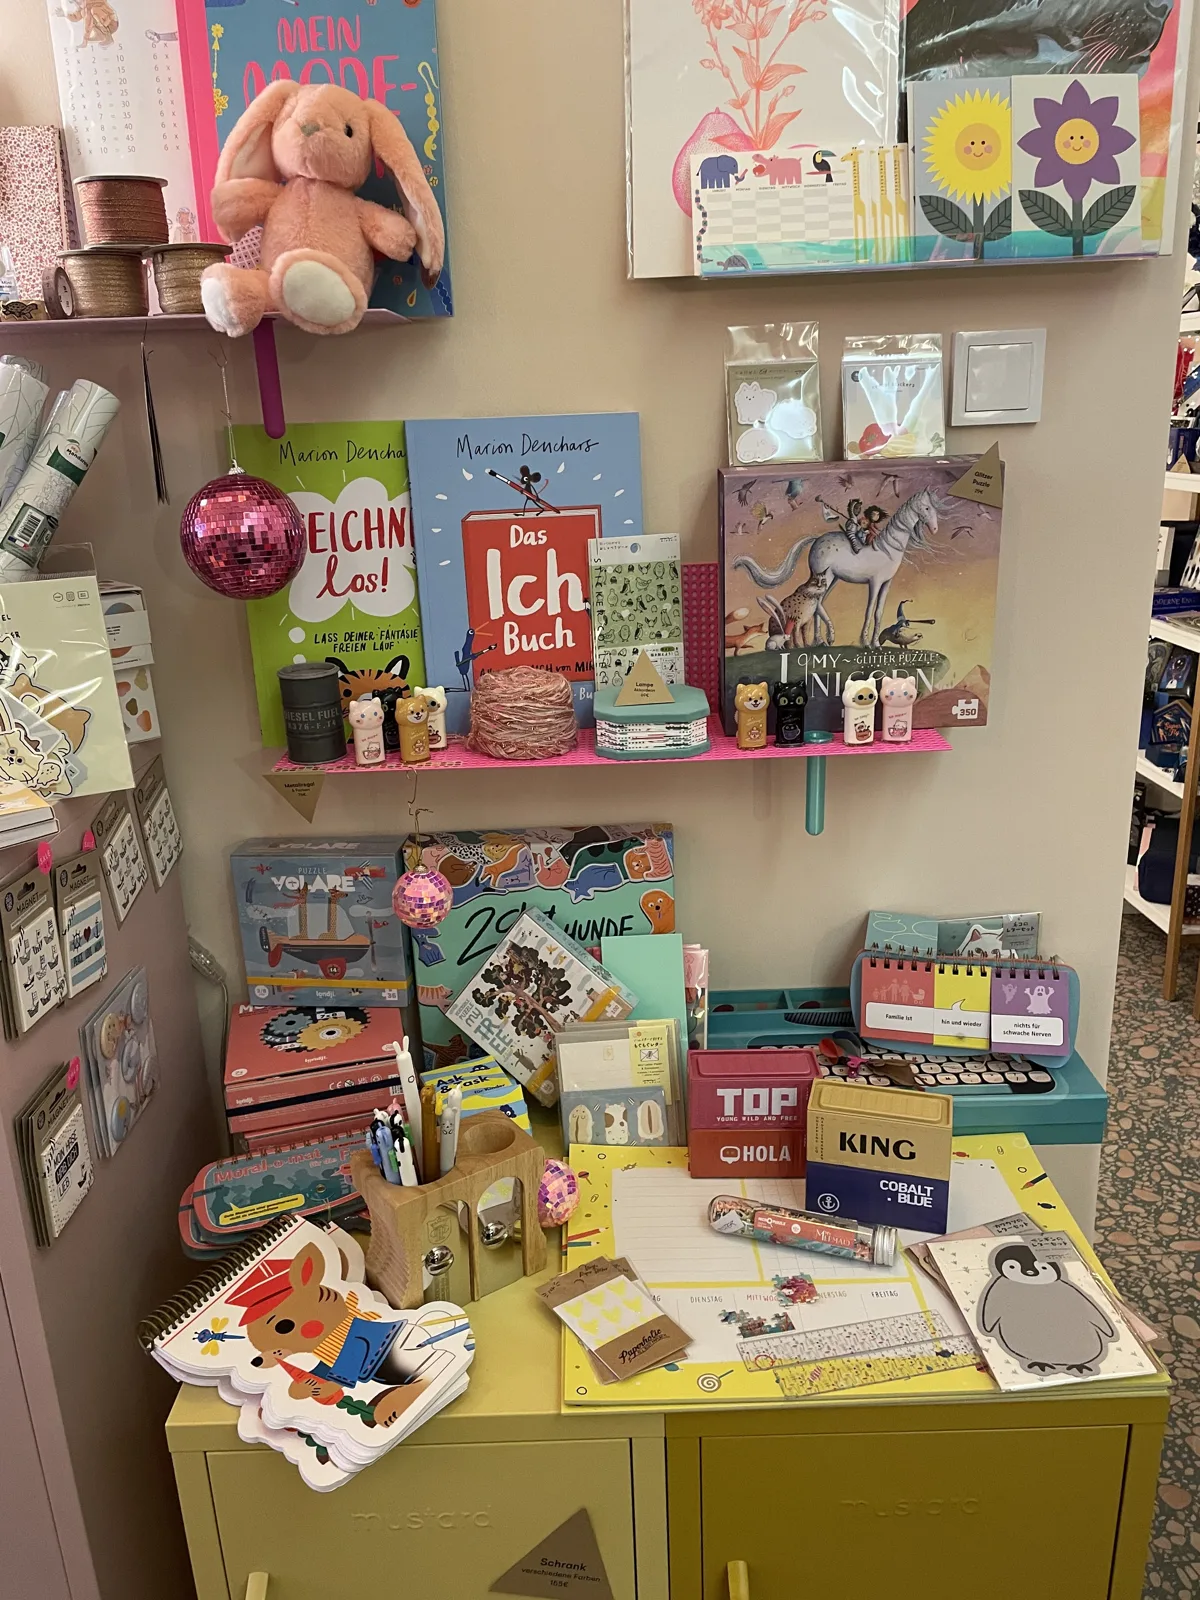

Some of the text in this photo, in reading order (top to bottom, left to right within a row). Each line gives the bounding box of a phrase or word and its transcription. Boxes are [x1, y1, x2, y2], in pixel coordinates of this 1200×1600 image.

[277, 15, 361, 53] MEIN
[279, 440, 407, 466] Marion Deucha
[457, 432, 599, 459] Marion Deuchars
[972, 479, 990, 487] Puzzle
[974, 471, 993, 480] Glitzer
[301, 507, 414, 553] EICHN
[510, 524, 547, 549] Das
[316, 554, 389, 599] los!
[486, 548, 586, 620] Ich
[314, 628, 418, 644] LASS DEINER FANTASIE
[503, 617, 576, 656] Buch
[333, 641, 395, 653] FREIEN LAUF
[555, 664, 572, 673] von
[813, 653, 935, 669] MY GLITTER PUZZLE
[317, 707, 340, 720] FUEL
[960, 707, 977, 717] 350
[279, 842, 360, 850] VOLARE
[69, 875, 90, 891] MAGNET
[271, 875, 356, 892] VOLARE
[16, 892, 39, 915] MAGNET
[465, 1007, 484, 1027] my
[885, 1013, 905, 1021] Familie
[962, 1020, 982, 1028] wieder
[1003, 1029, 1030, 1037] schwache
[437, 1075, 464, 1088] Ask
[440, 1075, 490, 1094] & ask
[485, 1084, 505, 1092] Kinder
[716, 1087, 798, 1116] TOP
[743, 1145, 792, 1162] HOLA
[839, 1131, 917, 1160] KING
[58, 1177, 70, 1197] LIEB
[880, 1180, 934, 1197] COBALT
[898, 1193, 933, 1208] BLUE
[690, 1290, 899, 1304] DIENSTAG MITTWOC NERSTAG FREITAG
[618, 1328, 662, 1365] Paperholic
[540, 1557, 588, 1571] Schrank
[521, 1567, 601, 1582] verschiedene Farben
